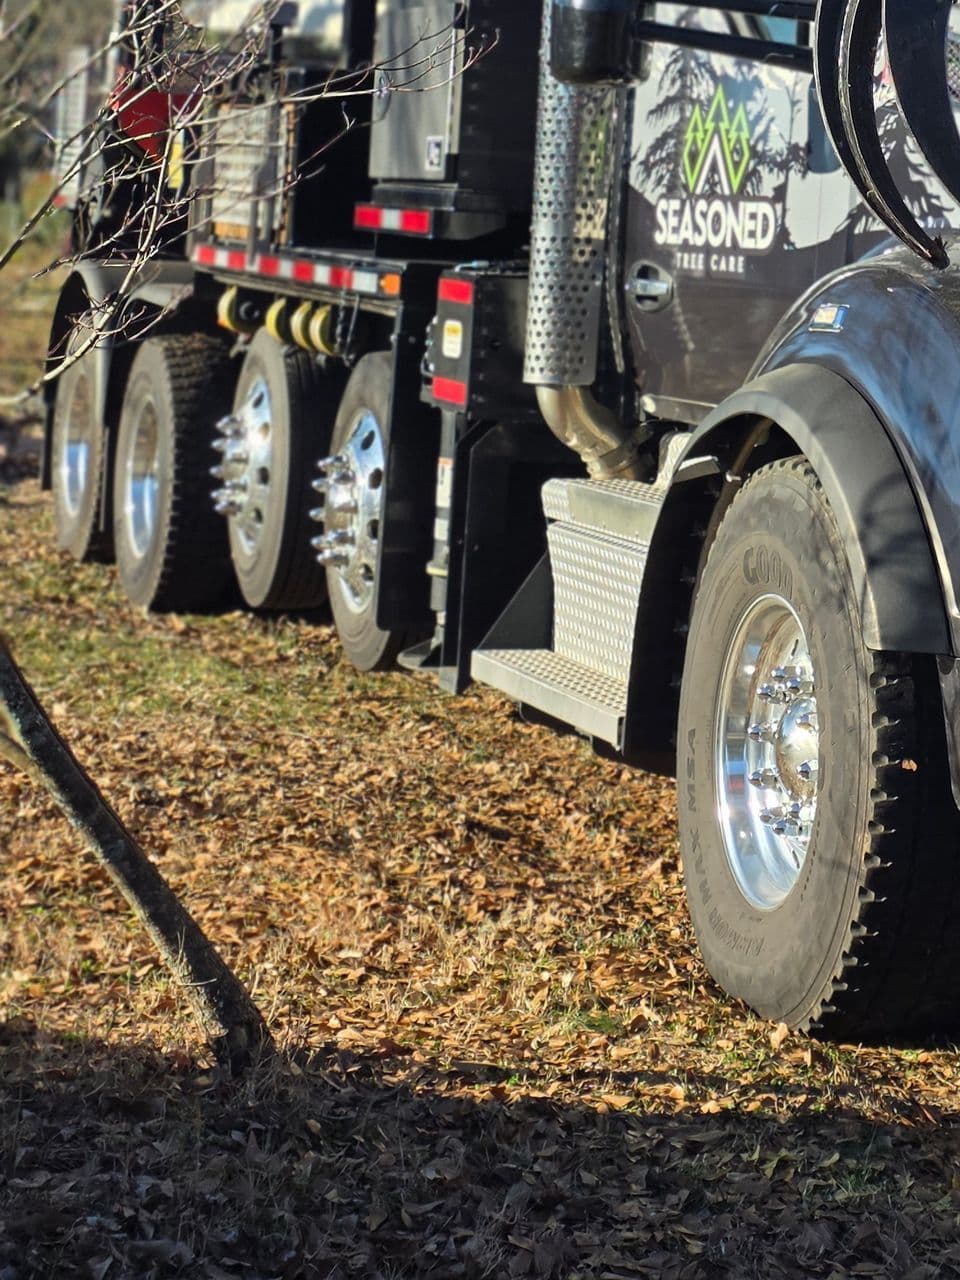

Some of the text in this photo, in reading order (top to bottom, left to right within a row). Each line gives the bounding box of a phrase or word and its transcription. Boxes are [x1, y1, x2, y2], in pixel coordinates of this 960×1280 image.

[654, 199, 776, 250] SEASONED
[676, 252, 746, 273] TREE CARE
